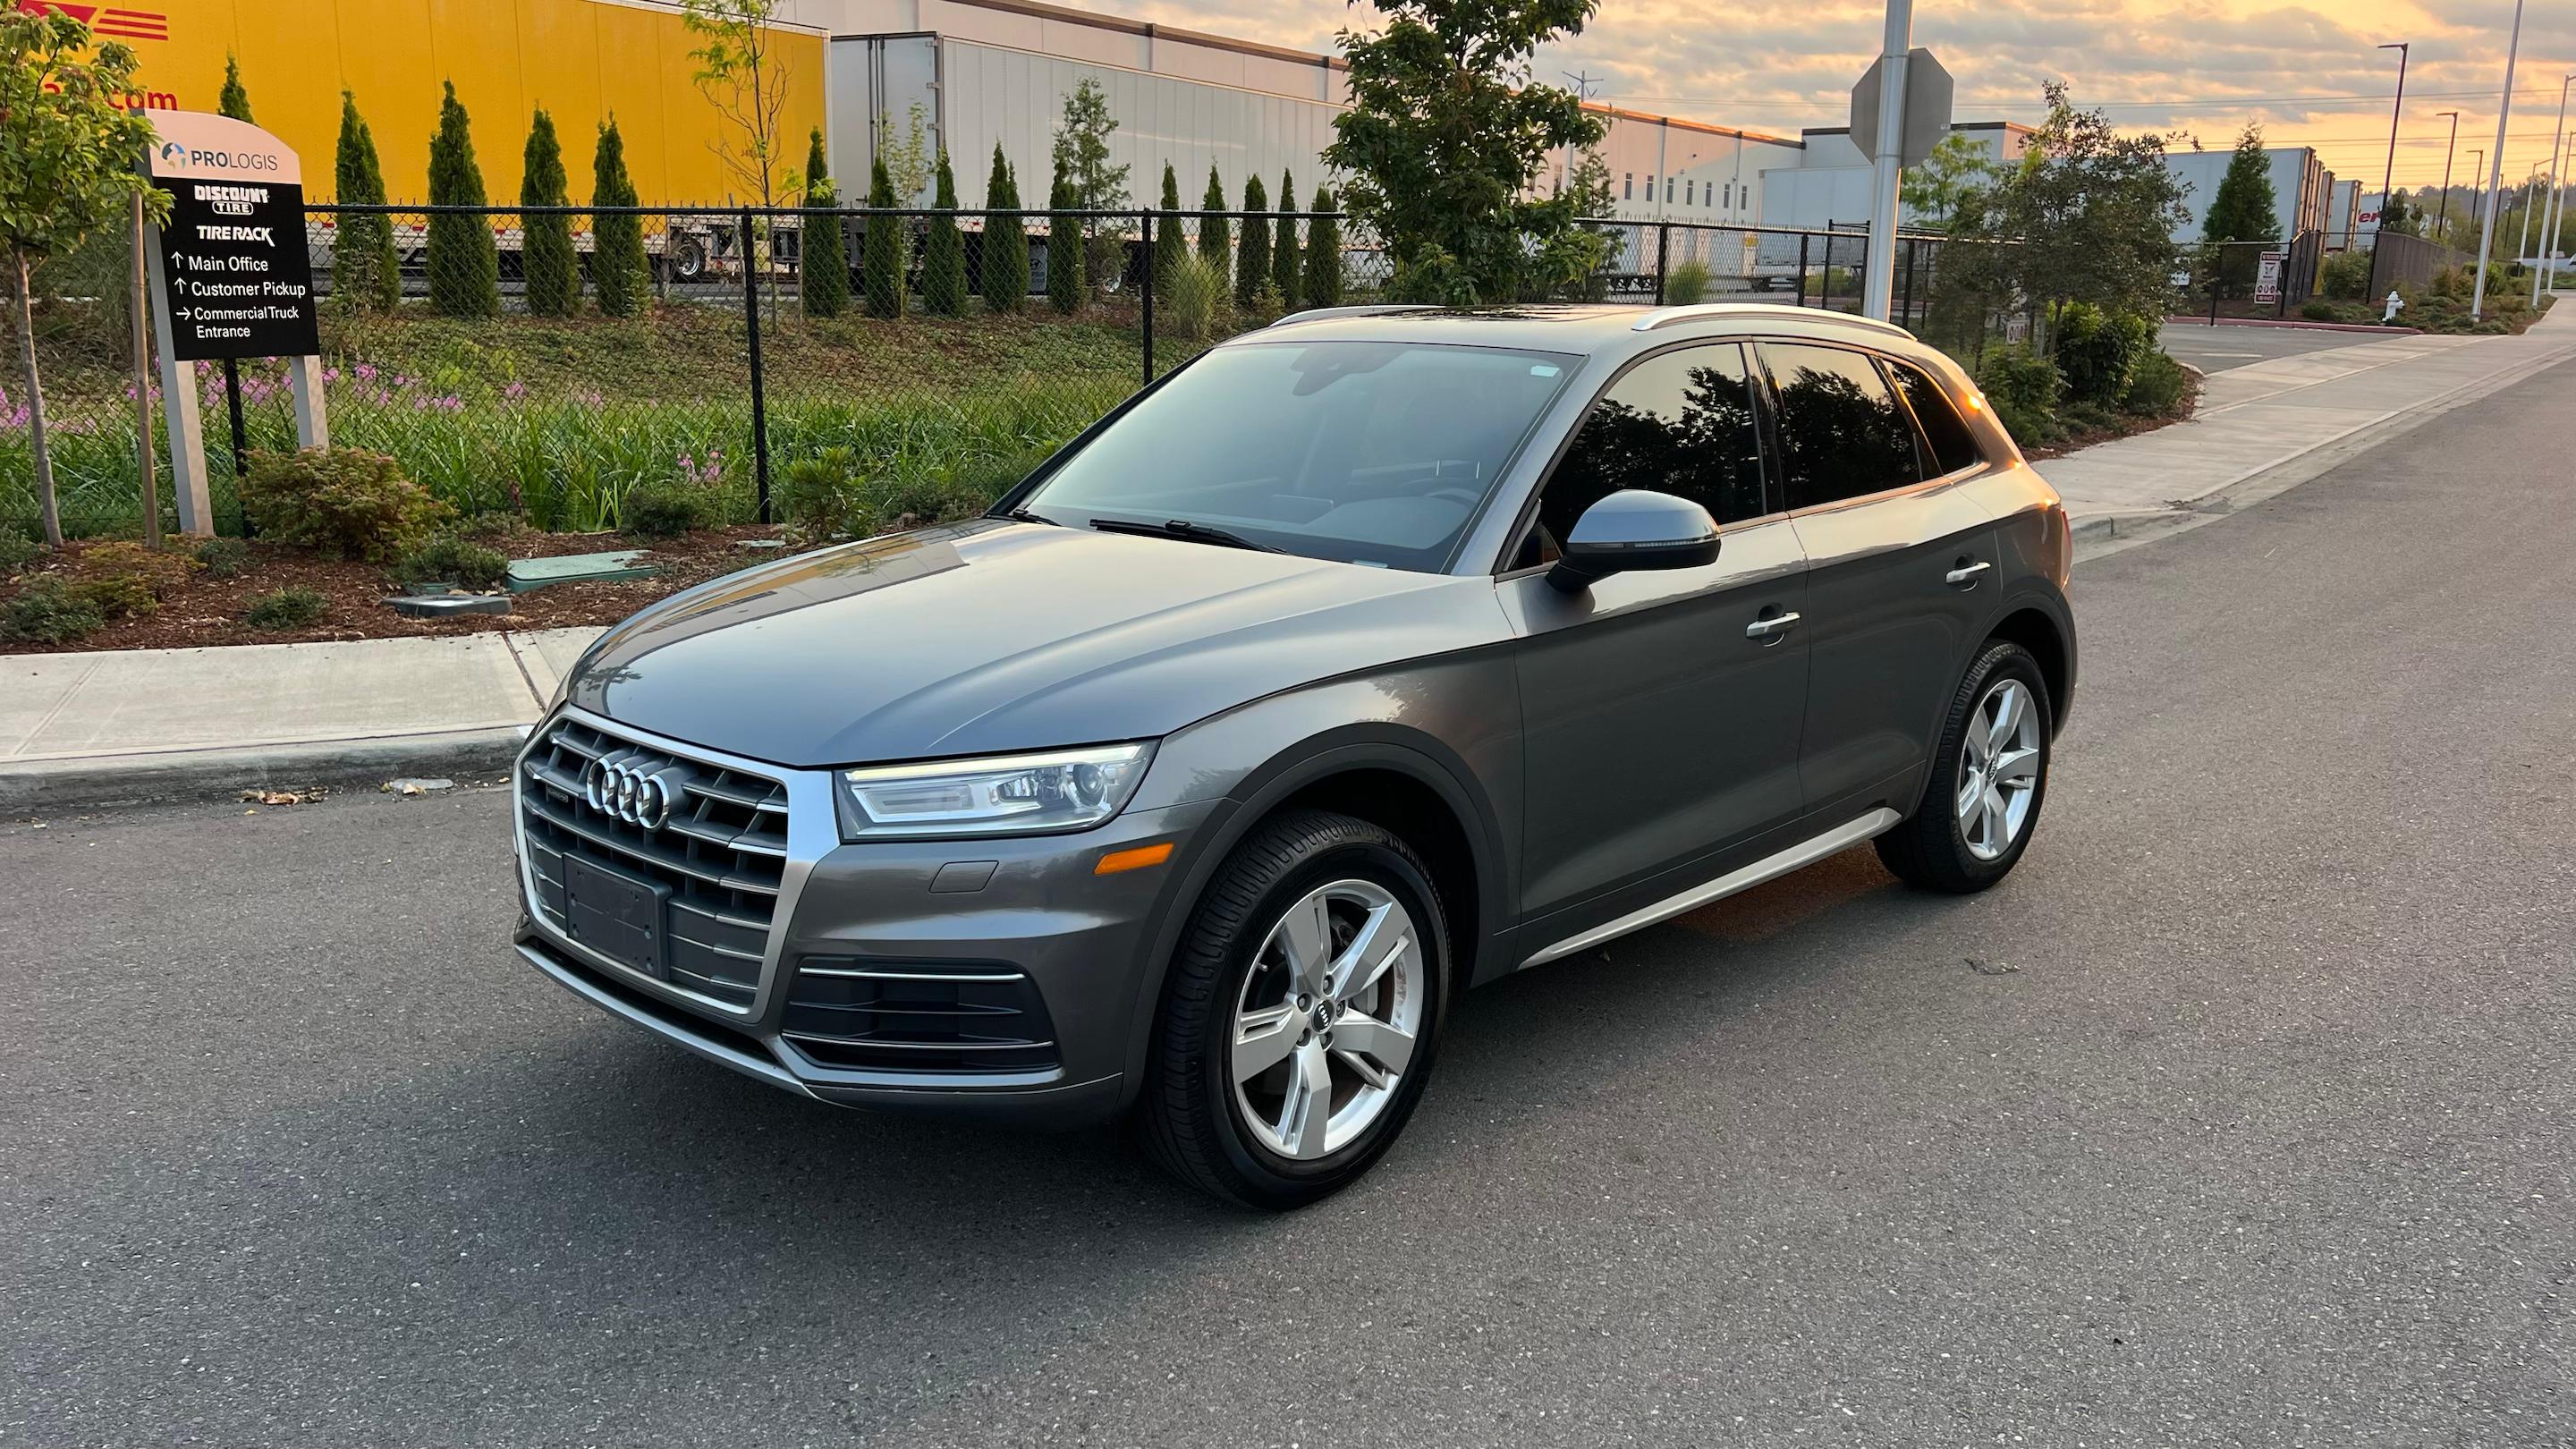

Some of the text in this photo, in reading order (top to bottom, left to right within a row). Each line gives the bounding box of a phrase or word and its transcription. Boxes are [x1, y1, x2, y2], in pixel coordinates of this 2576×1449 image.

[191, 150, 278, 171] PROLOGIS
[194, 184, 268, 204] DISCOUNT
[216, 202, 250, 213] TIRE
[196, 225, 275, 247] TIRE RACK
[188, 255, 269, 272] Main Office
[191, 281, 306, 299] Customer Pickup
[194, 305, 300, 320] Commercial Truck
[196, 325, 251, 339] Entrance
